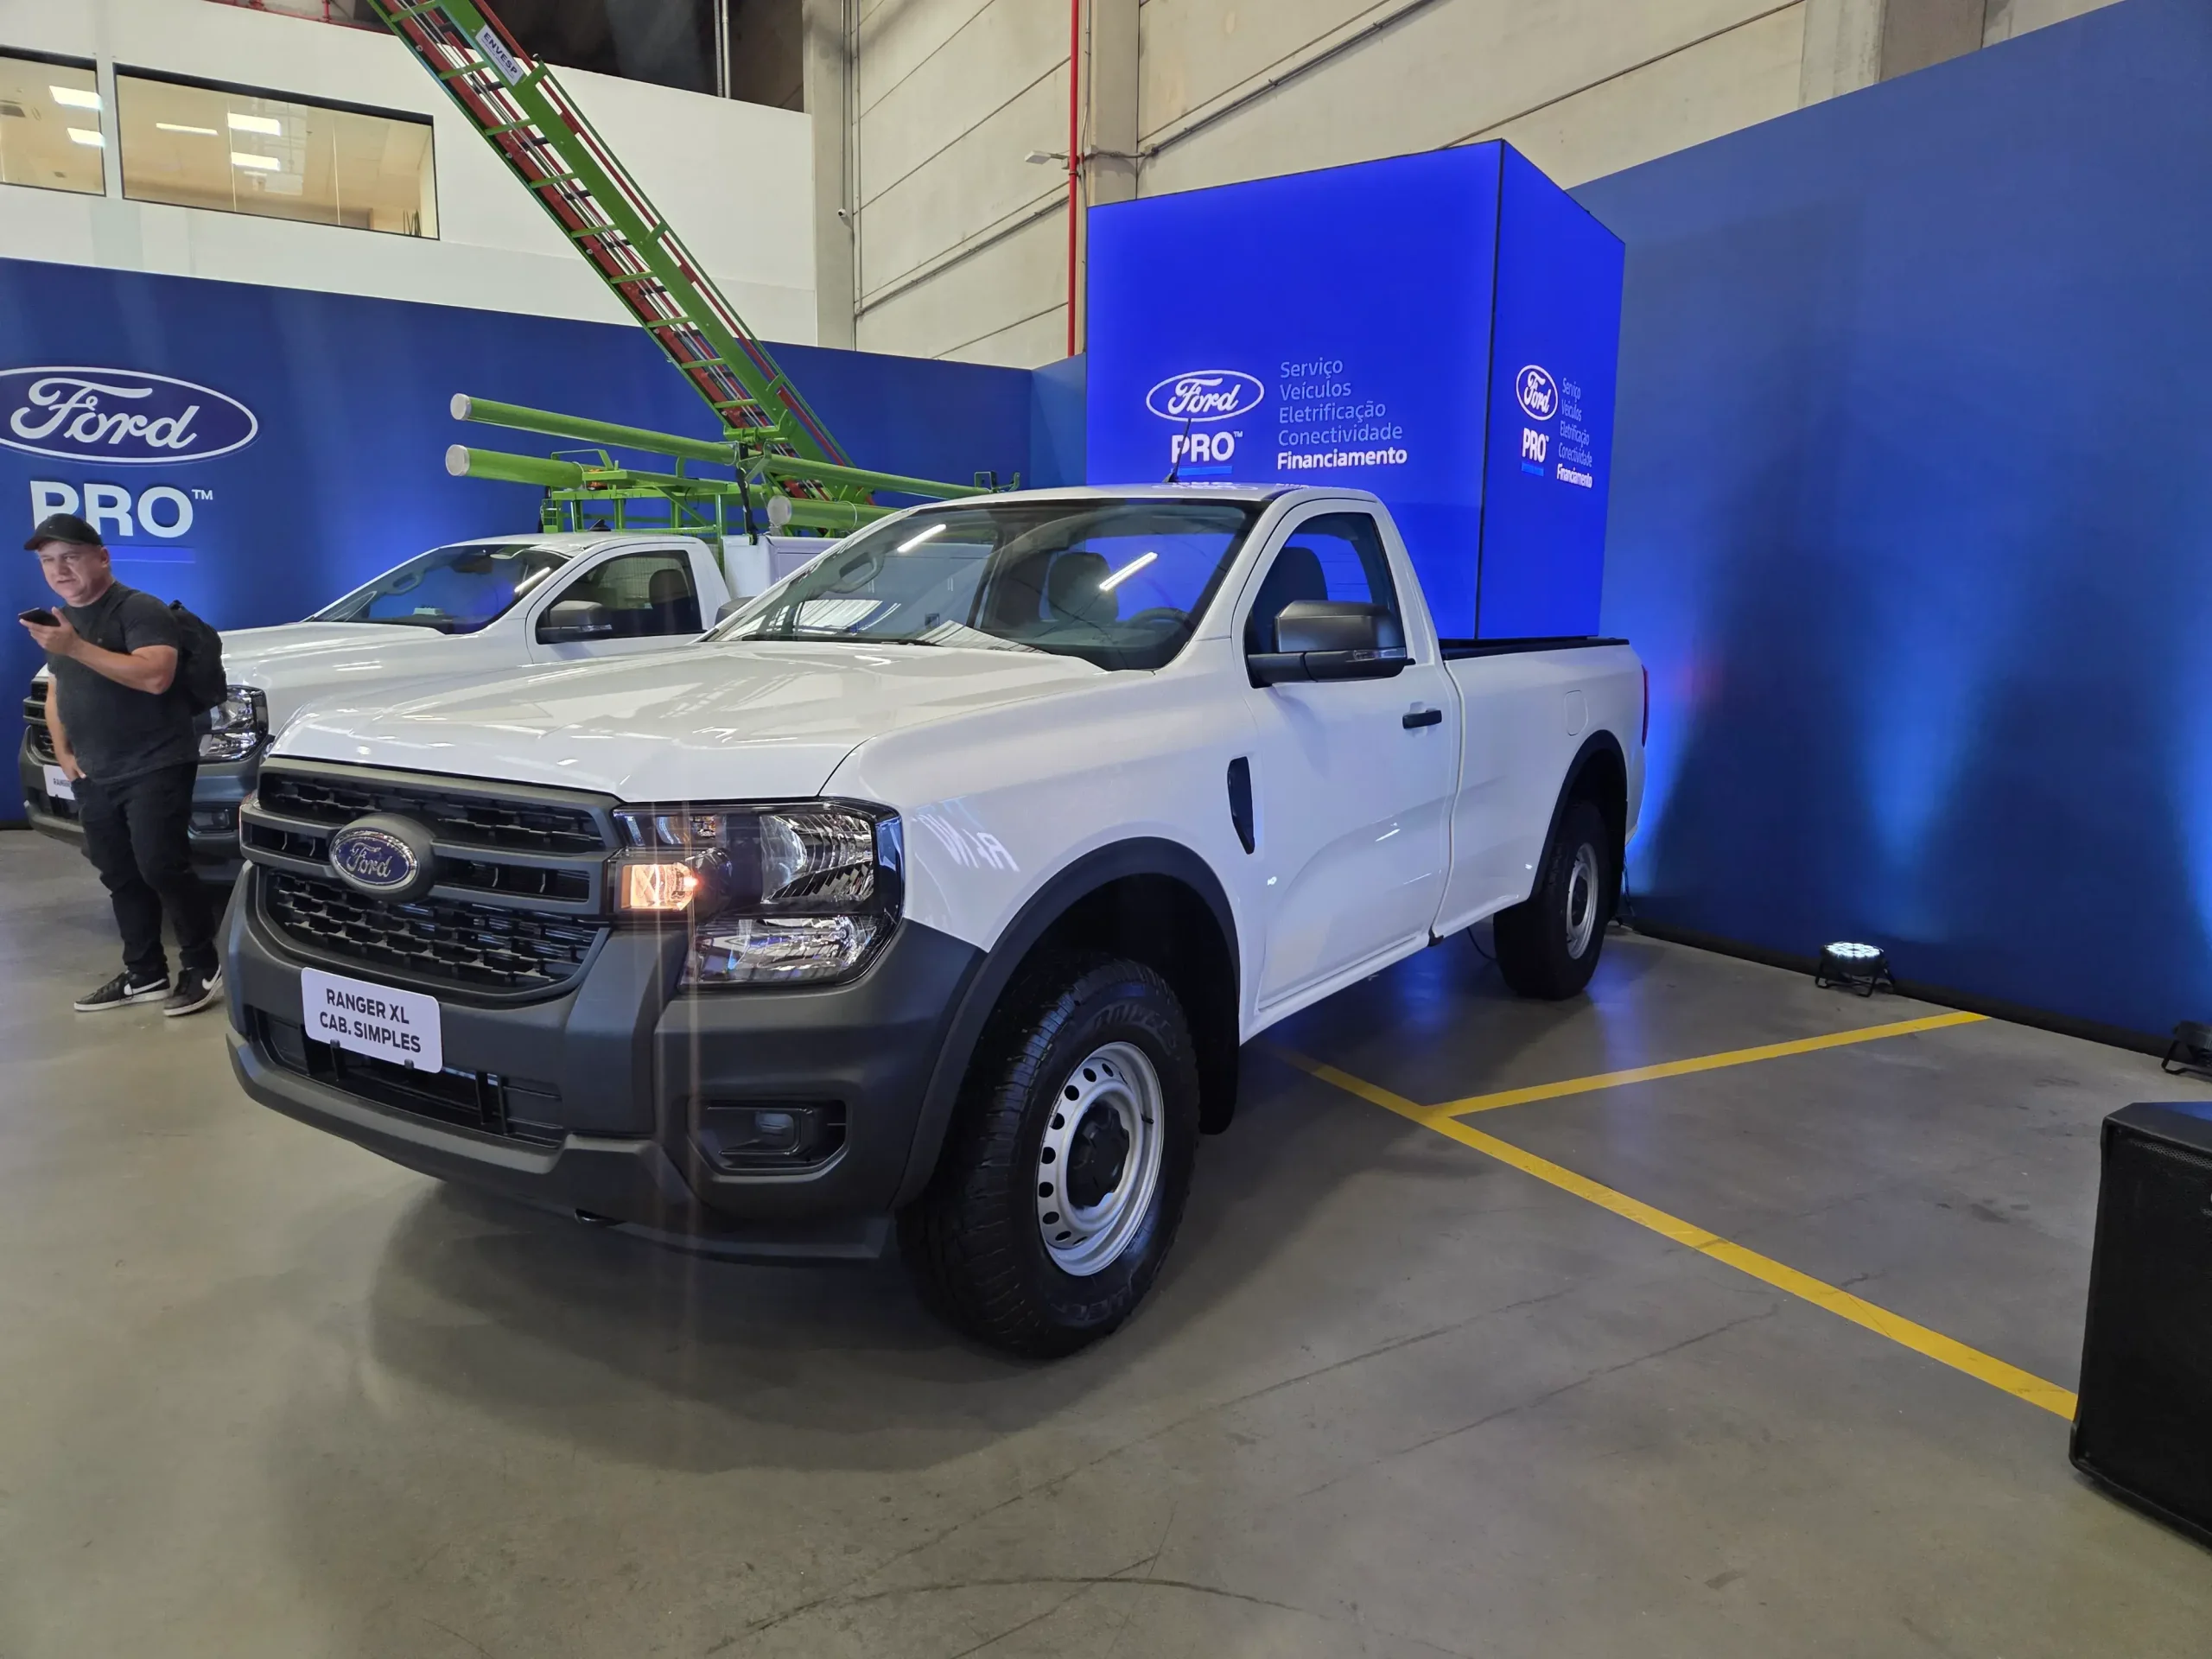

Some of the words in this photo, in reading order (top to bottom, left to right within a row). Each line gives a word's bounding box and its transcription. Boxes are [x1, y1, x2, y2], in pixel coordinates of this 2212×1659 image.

[483, 32, 518, 73] ENVESP
[1280, 357, 1344, 380] Serviço
[1167, 378, 1242, 416] Ford
[1280, 380, 1351, 401] Veículos
[1523, 371, 1552, 414] Ford
[1562, 377, 1581, 403] Serviço
[10, 377, 200, 449] Ford
[1279, 400, 1387, 424] Eletrificação
[1278, 422, 1403, 447] Conectividade
[1277, 446, 1408, 471] Financiamento
[1558, 442, 1592, 467] Conectividade
[1556, 463, 1593, 489] Financiamento
[346, 842, 392, 879] Ford
[326, 988, 387, 1020] RANGER
[389, 1005, 410, 1025] XL
[319, 1011, 352, 1036] CAB.
[353, 1020, 422, 1053] SIMPLES
